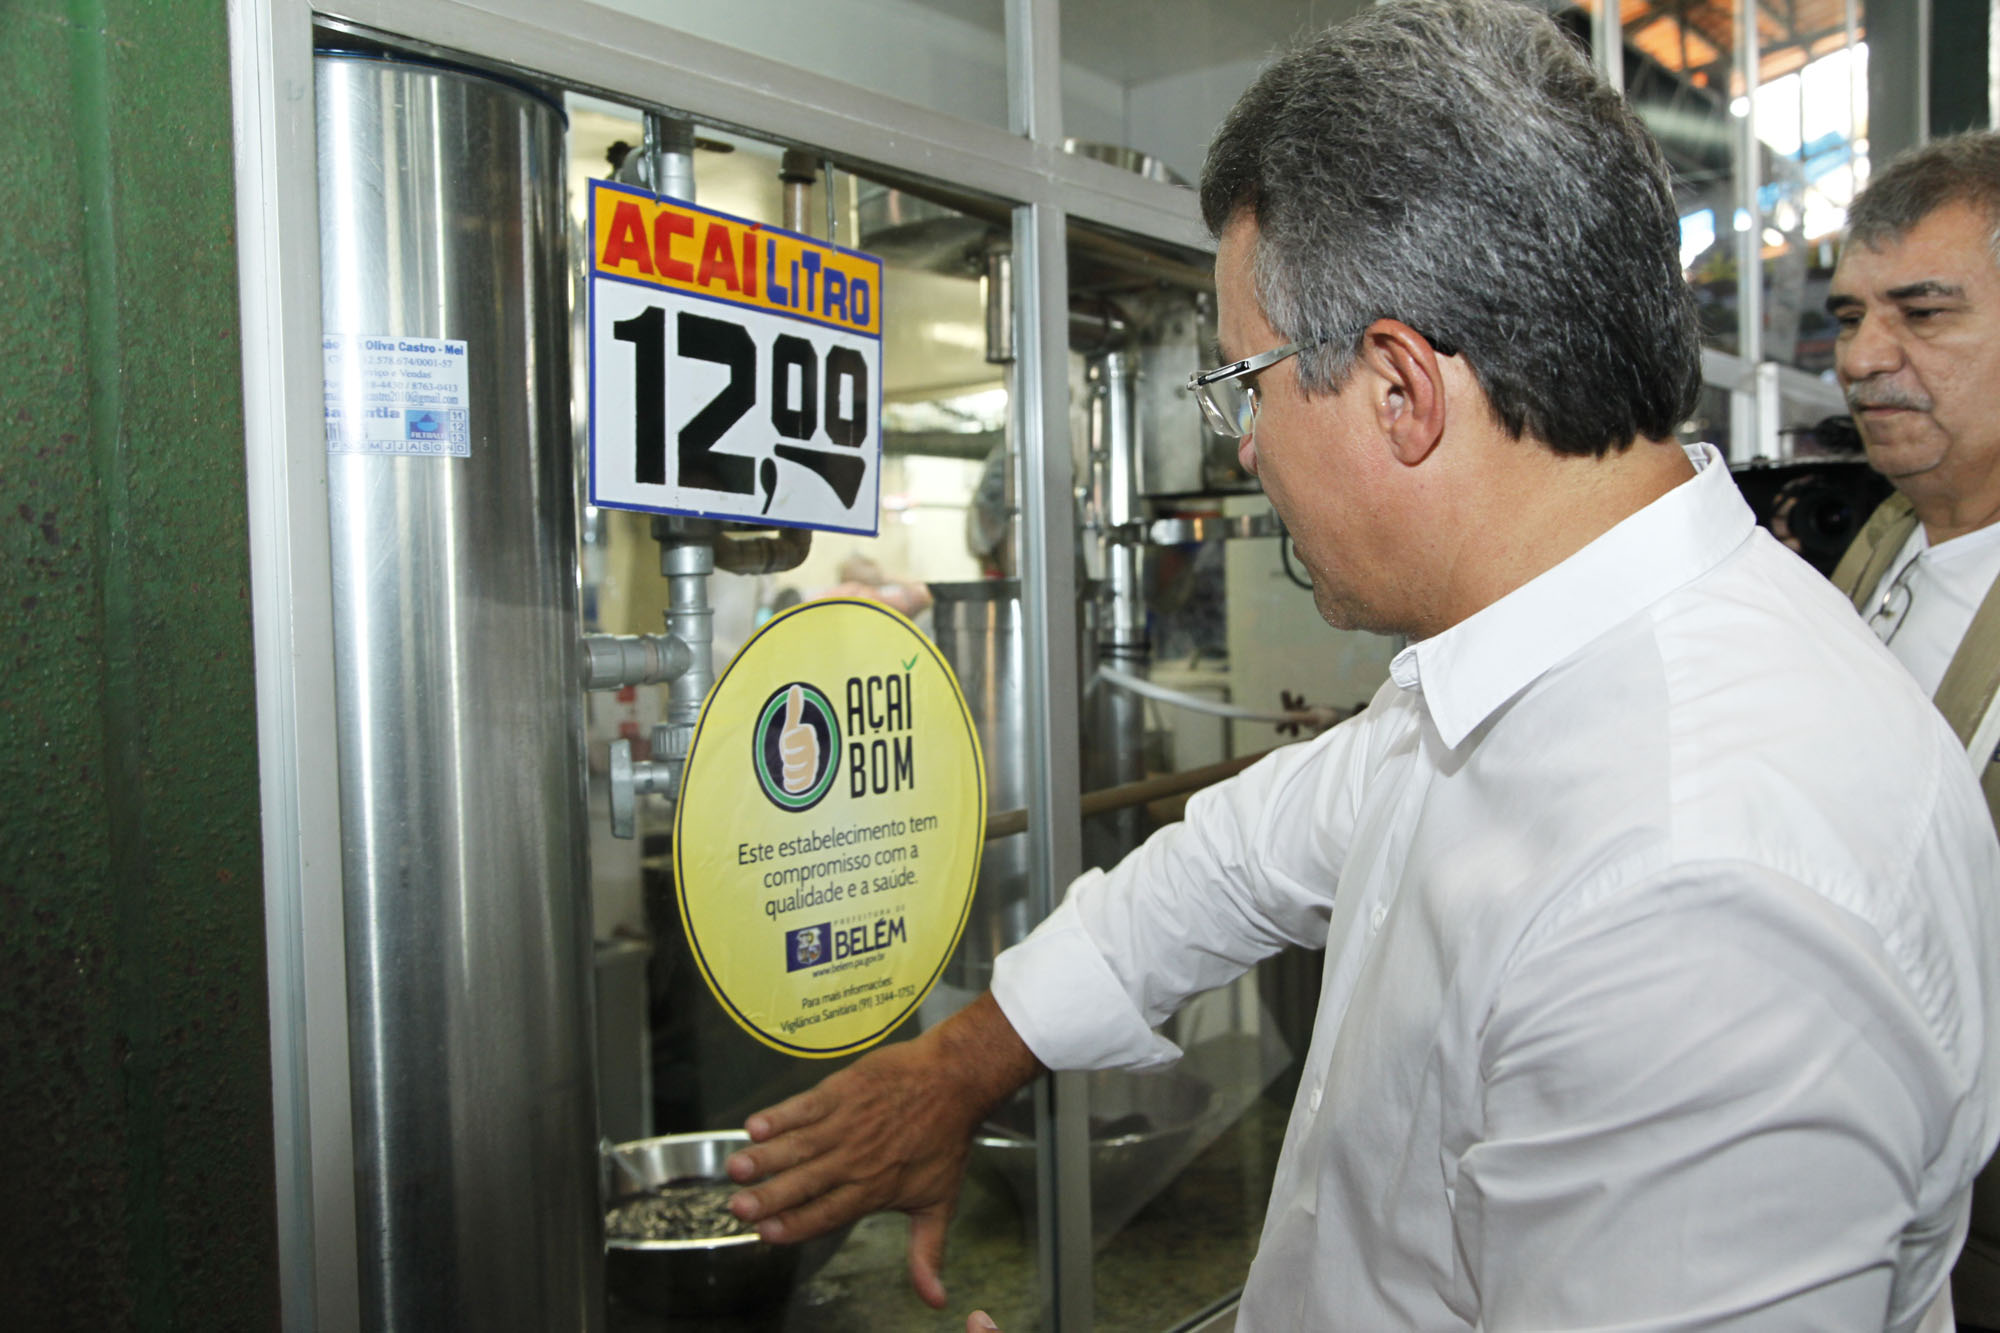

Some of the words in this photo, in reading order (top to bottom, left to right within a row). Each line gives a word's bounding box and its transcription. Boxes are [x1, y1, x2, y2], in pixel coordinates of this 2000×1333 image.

[766, 238, 870, 327] LITRO
[366, 340, 394, 351] Oliva
[399, 342, 436, 353] Castro
[444, 344, 463, 356] Mei
[400, 369, 432, 379] Vendas
[452, 423, 463, 432] 12
[453, 433, 464, 443] 13
[848, 735, 914, 799] BOM
[738, 843, 774, 865] Este
[778, 820, 906, 858] estabelecimento
[910, 815, 938, 834] tem
[763, 852, 871, 889] compromisso
[875, 846, 907, 866] com
[910, 845, 919, 858] a
[765, 882, 843, 921] qualidade
[847, 884, 857, 898] e
[860, 880, 870, 895] a
[873, 866, 918, 894] saúde.
[833, 908, 891, 926] PREFEITURA
[835, 916, 907, 960] BELÉM
[812, 953, 885, 978] www.belem.pa.gov.br
[801, 995, 820, 1010] Para
[822, 990, 841, 1004] mais
[780, 1013, 821, 1034] Vigilância
[823, 1003, 857, 1022] Sanitária
